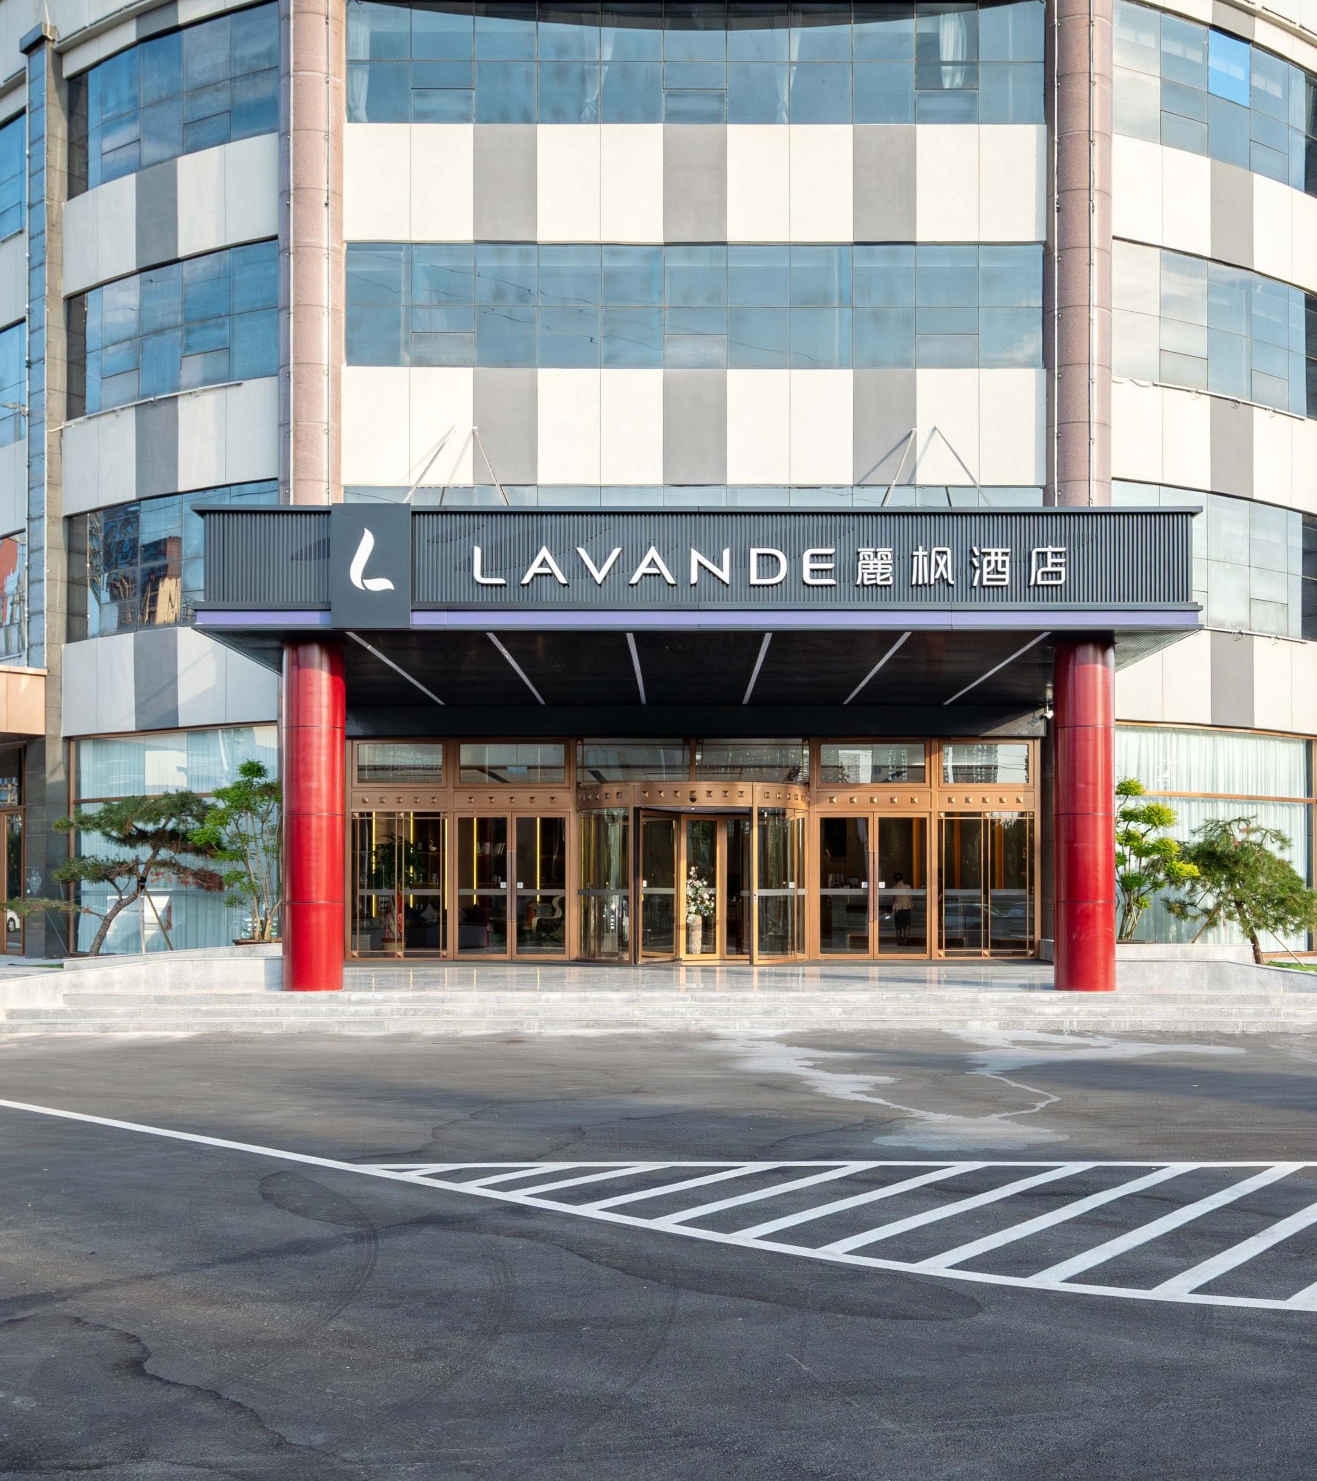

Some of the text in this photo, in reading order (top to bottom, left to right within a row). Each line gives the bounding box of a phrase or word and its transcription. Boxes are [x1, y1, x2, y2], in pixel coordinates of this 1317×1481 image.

[472, 544, 1068, 587] LAVANDE 麗枫酒店
